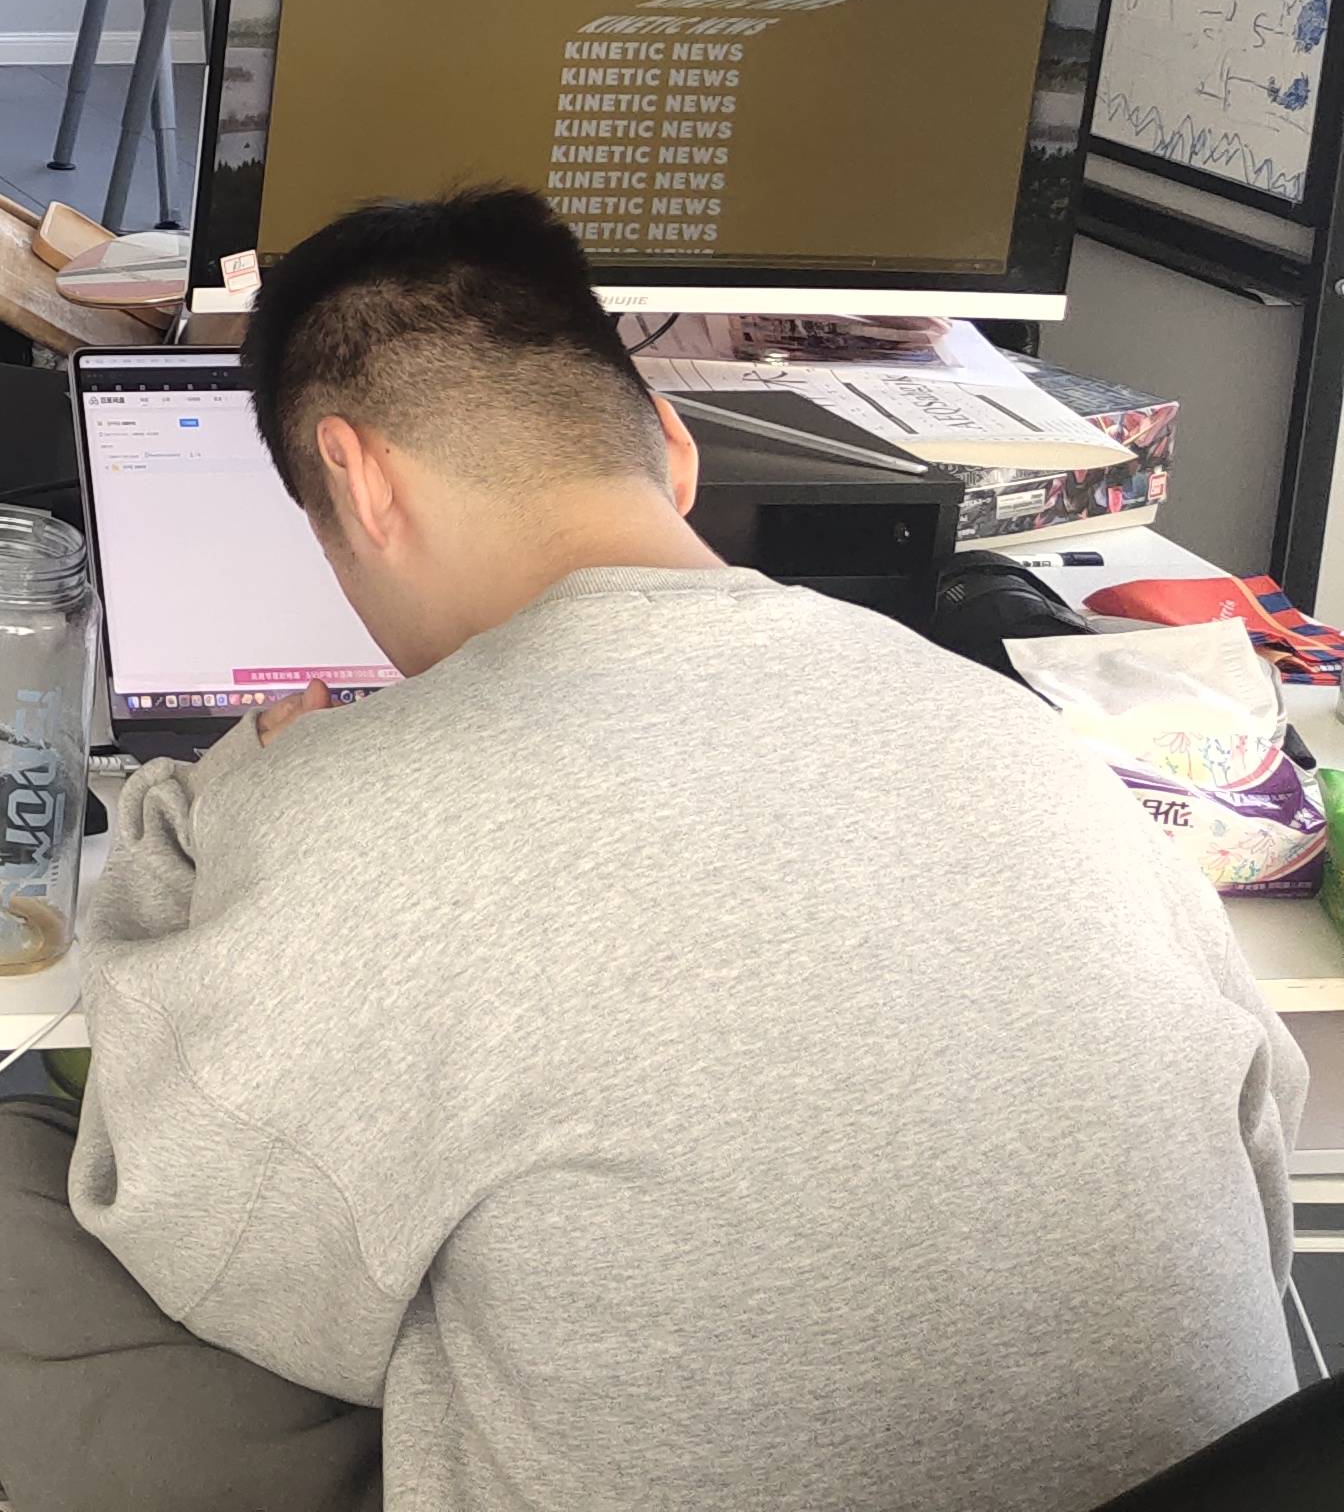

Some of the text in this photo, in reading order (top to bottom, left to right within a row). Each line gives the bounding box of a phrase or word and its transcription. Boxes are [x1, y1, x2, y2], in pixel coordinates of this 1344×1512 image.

[685, 18, 780, 35] NEWS
[564, 42, 744, 61] KINETIC NEWS
[561, 67, 739, 87] KINETIC NEWS
[558, 93, 736, 113] KINETIC NEWS
[554, 119, 733, 139] KINETIC NEWS
[550, 145, 729, 164] KINETIC NEWS
[547, 171, 725, 190] KINETIC NEWS
[651, 198, 722, 216] NEWS
[648, 223, 718, 241] NEWS
